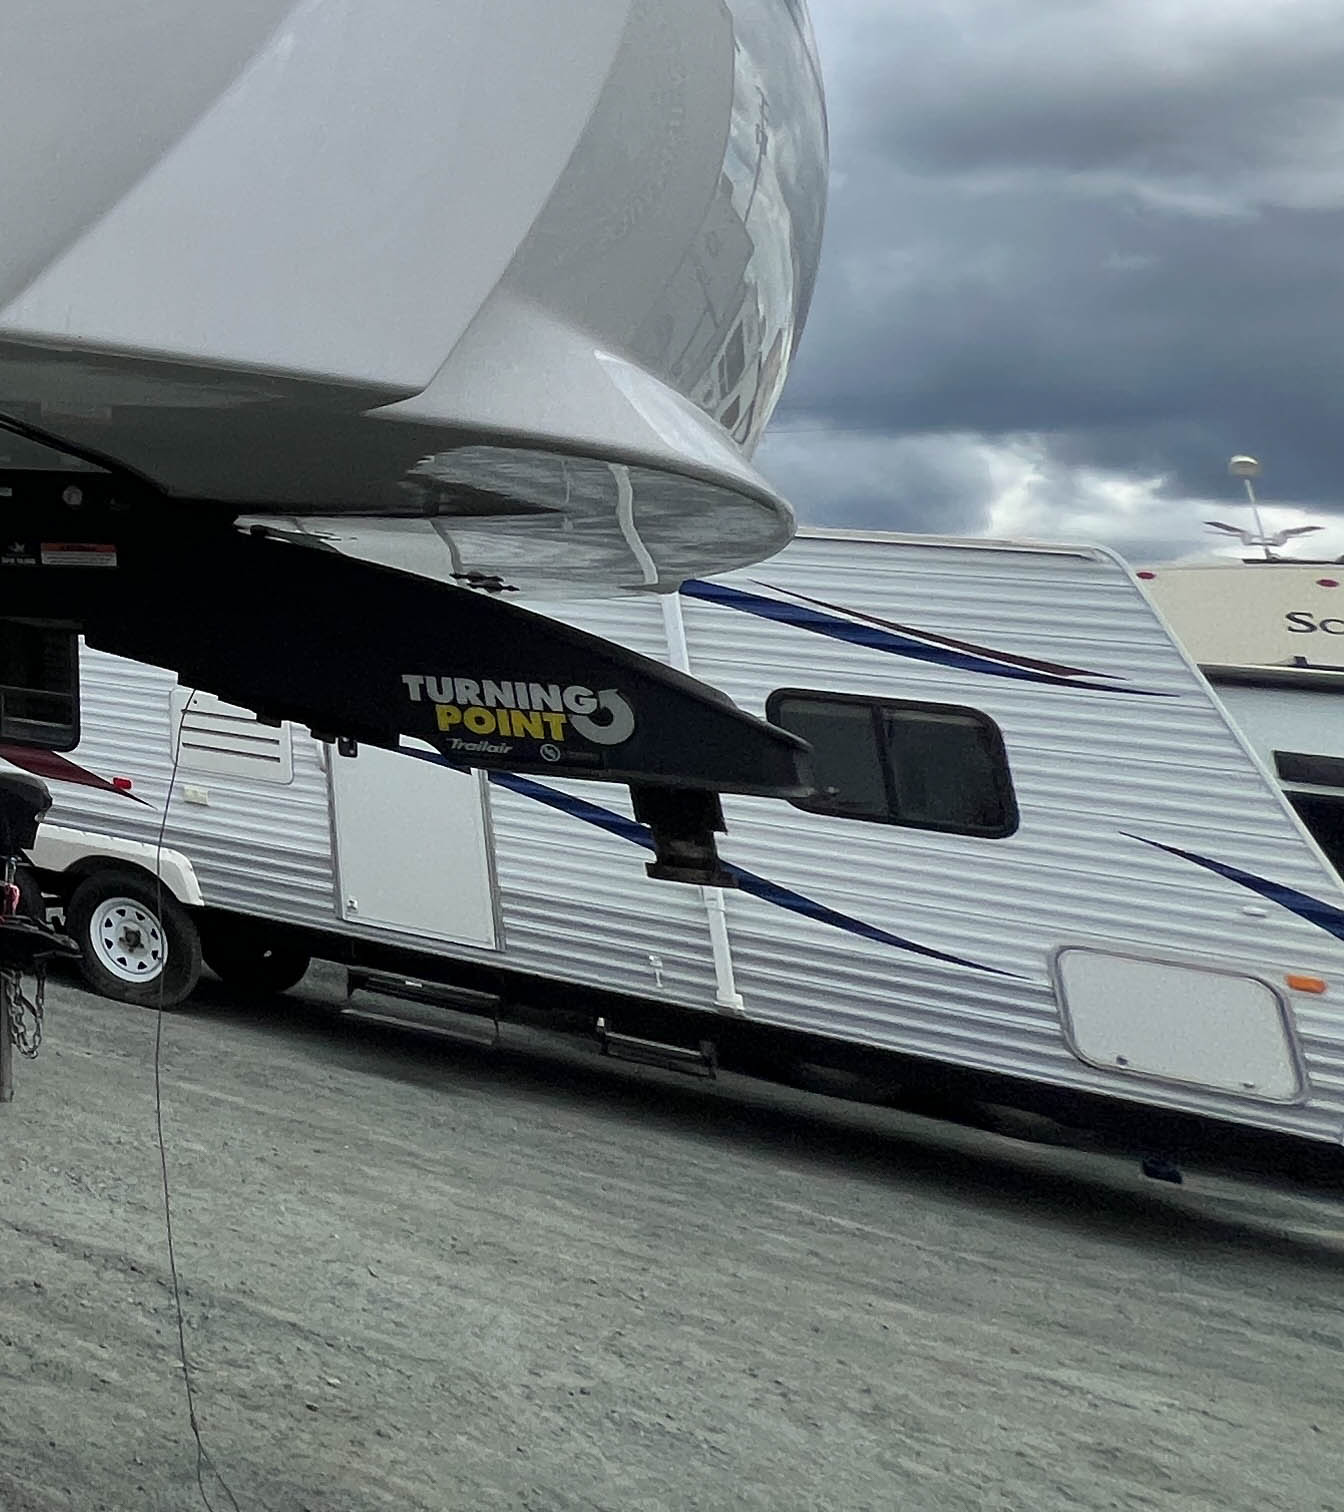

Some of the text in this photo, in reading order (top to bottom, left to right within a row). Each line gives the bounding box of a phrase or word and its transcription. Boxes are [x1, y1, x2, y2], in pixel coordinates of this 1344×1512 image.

[401, 674, 598, 714] TURNING
[435, 704, 568, 742] POINT
[449, 738, 513, 754] Trailair
